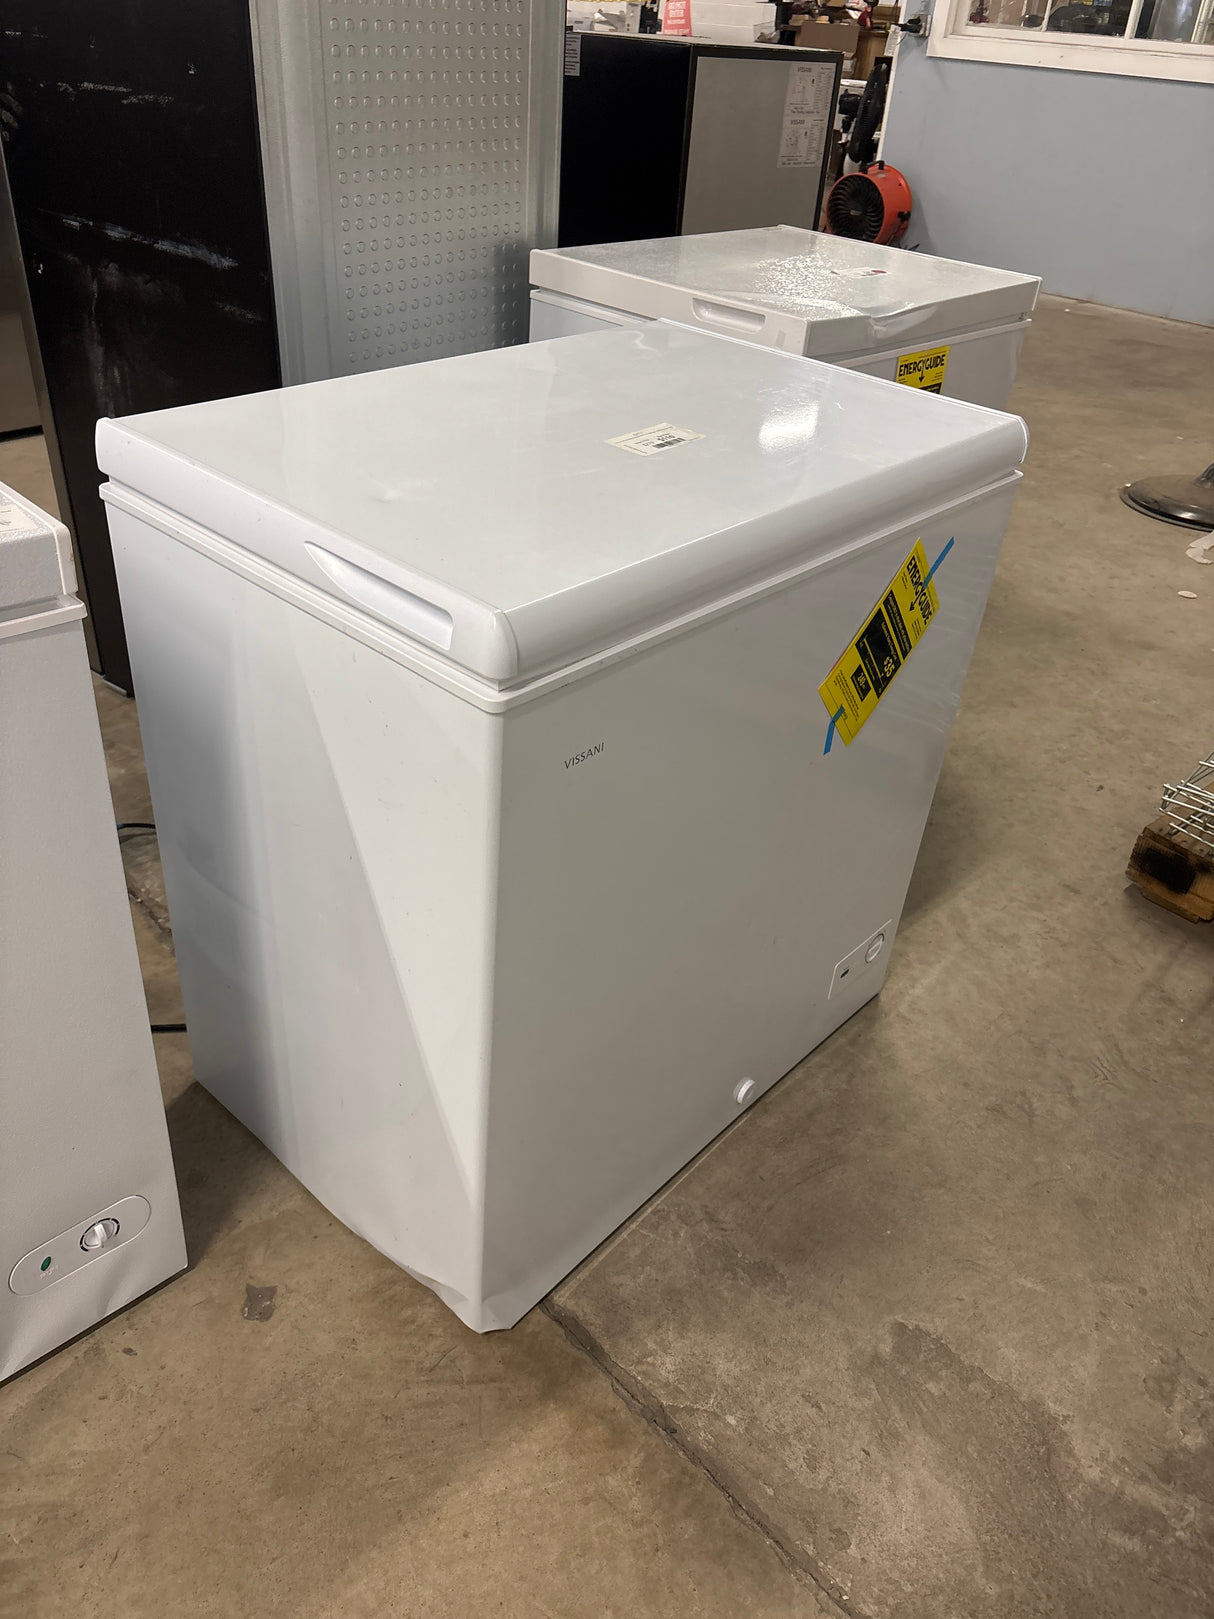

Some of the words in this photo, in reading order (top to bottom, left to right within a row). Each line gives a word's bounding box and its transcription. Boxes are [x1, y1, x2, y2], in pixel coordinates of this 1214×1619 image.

[898, 354, 947, 377] ENERGYGUIDE
[906, 555, 933, 625] ENERGYGUIDE
[564, 741, 605, 769] VISSANI
